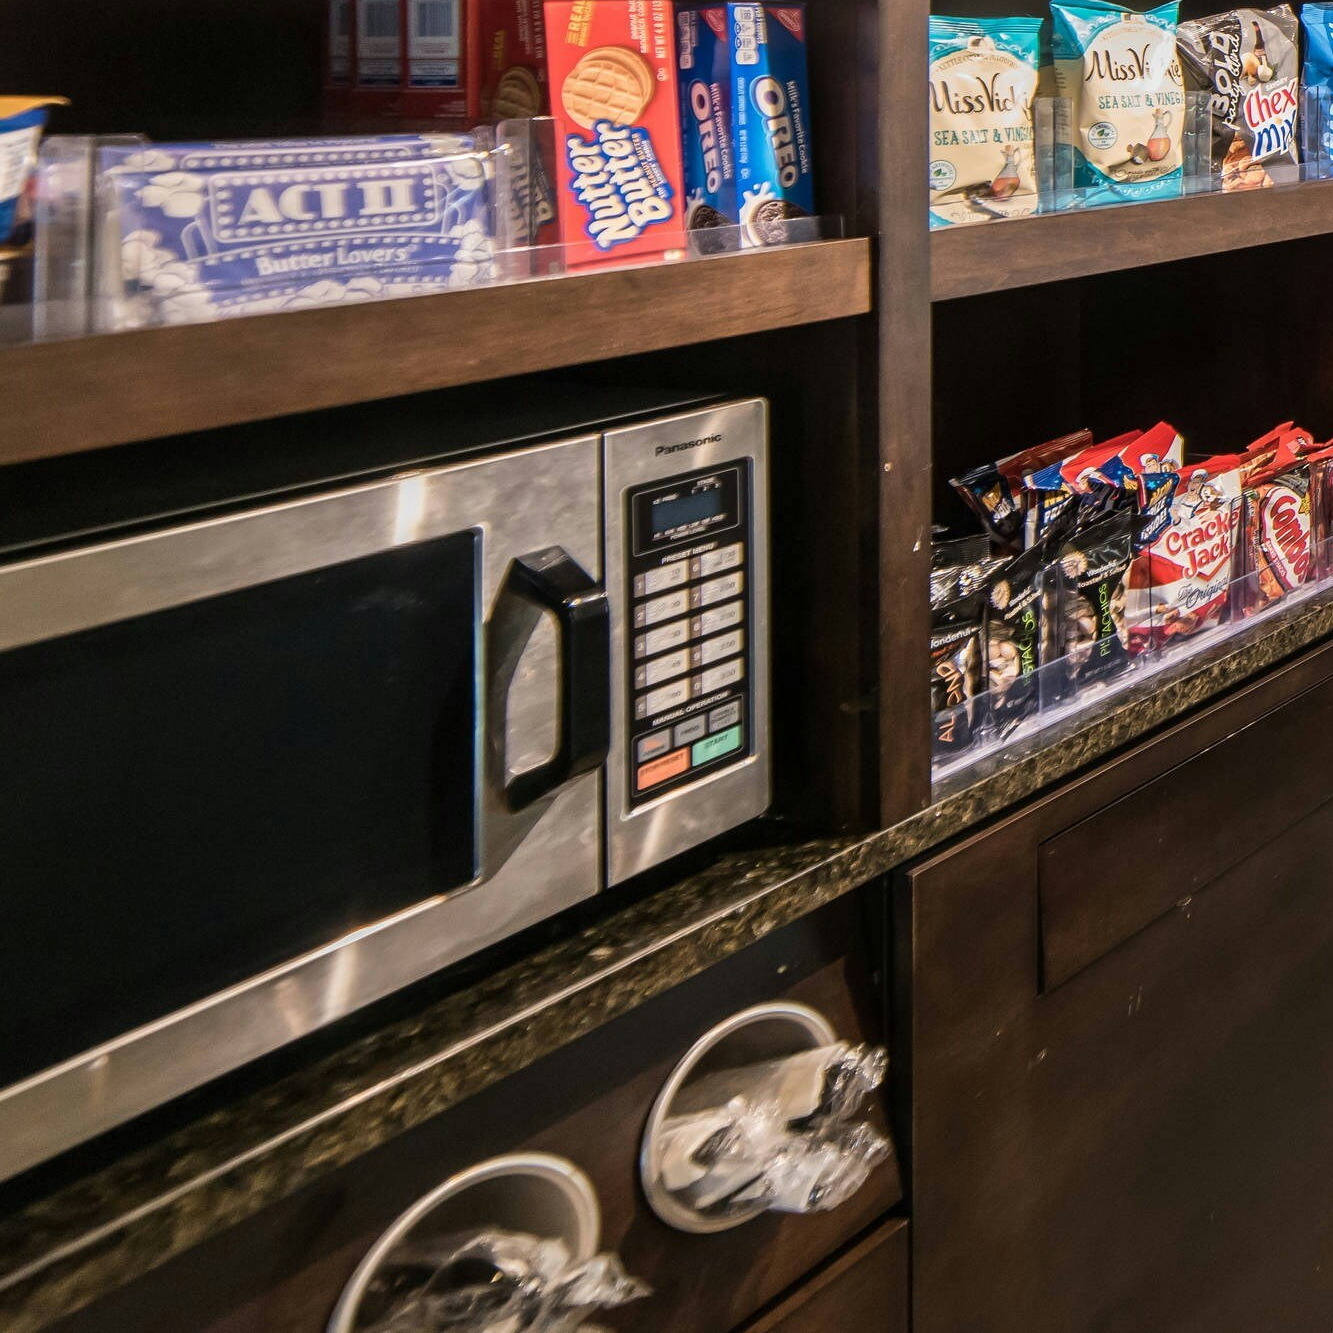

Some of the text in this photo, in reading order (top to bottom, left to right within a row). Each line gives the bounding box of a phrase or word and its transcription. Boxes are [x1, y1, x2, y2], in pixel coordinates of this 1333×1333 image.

[654, 12, 664, 21] OZ
[638, 19, 649, 54] sandwich
[655, 35, 666, 45] WT
[655, 45, 667, 59] NET
[1085, 49, 1136, 82] Miss
[1210, 30, 1233, 118] BOLD
[1099, 96, 1119, 110] SEA
[1121, 94, 1142, 109] SALT
[1145, 94, 1154, 109] &
[1246, 81, 1297, 130] Chex
[691, 81, 720, 194] OREO
[708, 83, 731, 179] Milk's Favorite Cookie
[755, 77, 798, 188] OREO
[785, 80, 808, 175] Milk's Favorite Cookie
[934, 128, 1002, 146] SEA SALT &
[1255, 109, 1297, 158] mix
[596, 122, 672, 226] Butter
[238, 179, 418, 226] ACT II
[568, 137, 638, 248] Nutter
[256, 252, 332, 276] Butter
[655, 434, 722, 457] Panasonic
[1165, 508, 1238, 556] Cracke
[661, 548, 692, 565] PRESET
[1183, 537, 1230, 578] Jack
[1186, 577, 1230, 608] Original
[652, 691, 730, 727] MANUAL OPERATION
[704, 733, 728, 749] START
